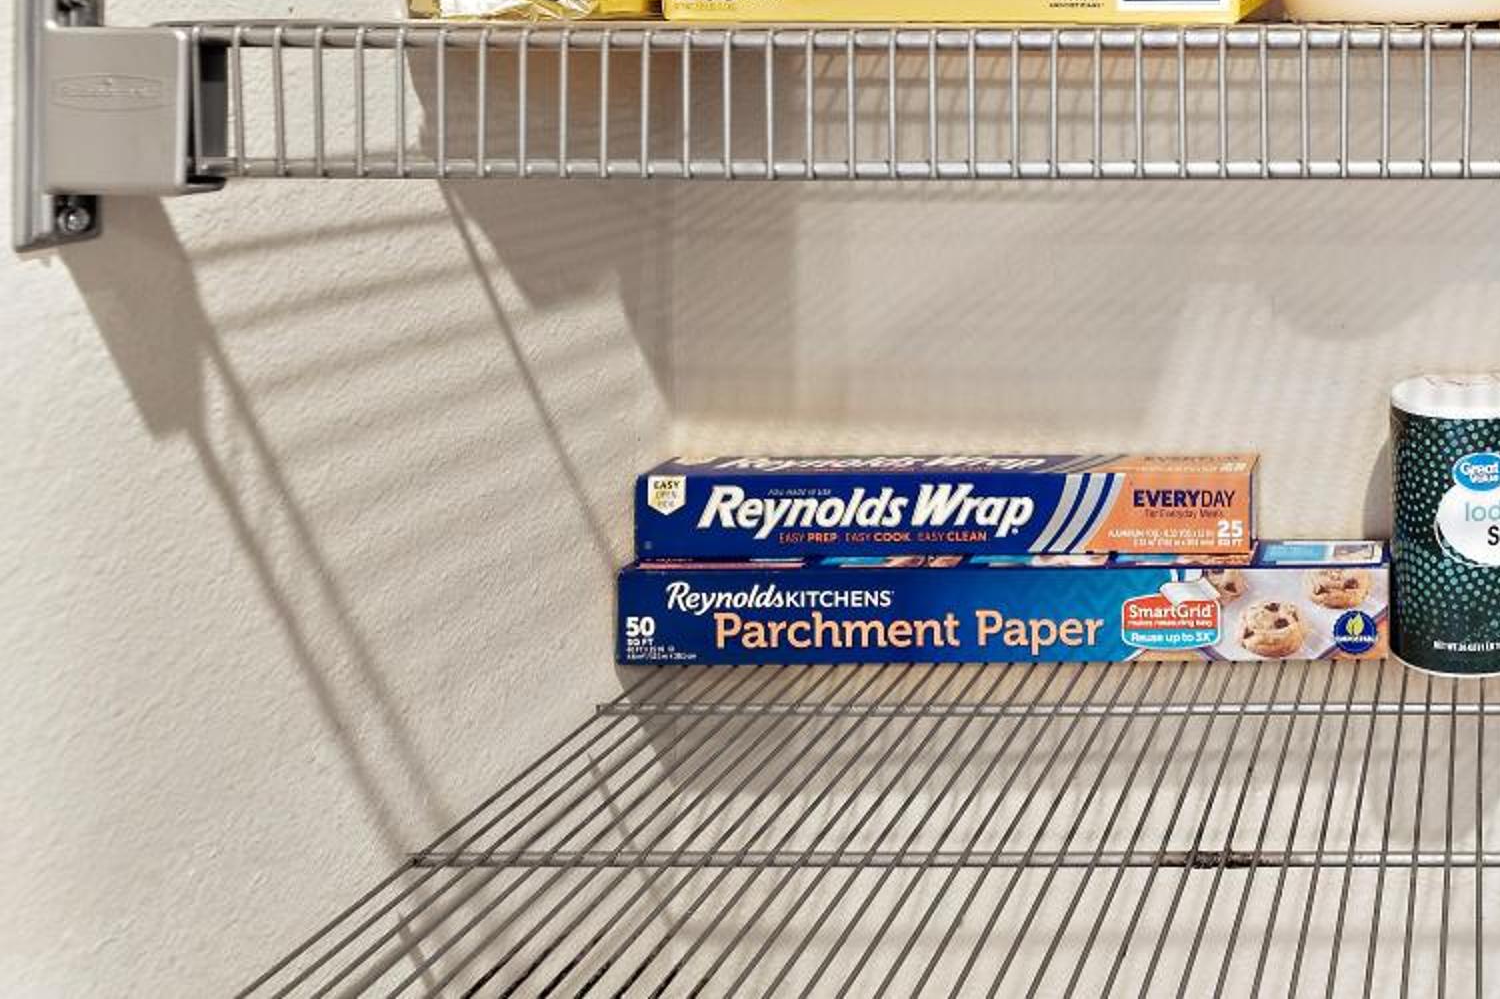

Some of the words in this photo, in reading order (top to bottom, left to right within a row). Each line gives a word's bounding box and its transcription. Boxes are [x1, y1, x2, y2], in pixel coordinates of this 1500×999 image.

[1460, 462, 1499, 476] Great
[654, 481, 681, 490] EASY
[1133, 489, 1236, 508] EVERYDAY
[696, 484, 909, 540] Reynolds
[911, 483, 1035, 538] Wrap
[807, 532, 838, 543] PREP
[874, 532, 912, 543] COOK
[917, 532, 944, 542] EASY
[946, 531, 988, 542] CLEAN
[1217, 520, 1243, 538] 25
[1129, 604, 1212, 618] SmartGrid
[626, 616, 656, 638] 50
[713, 610, 960, 649] Parchment
[975, 609, 1105, 656] Paper
[1131, 632, 1164, 642] Reuse
[1166, 633, 1181, 644] up
[1182, 633, 1194, 642] to
